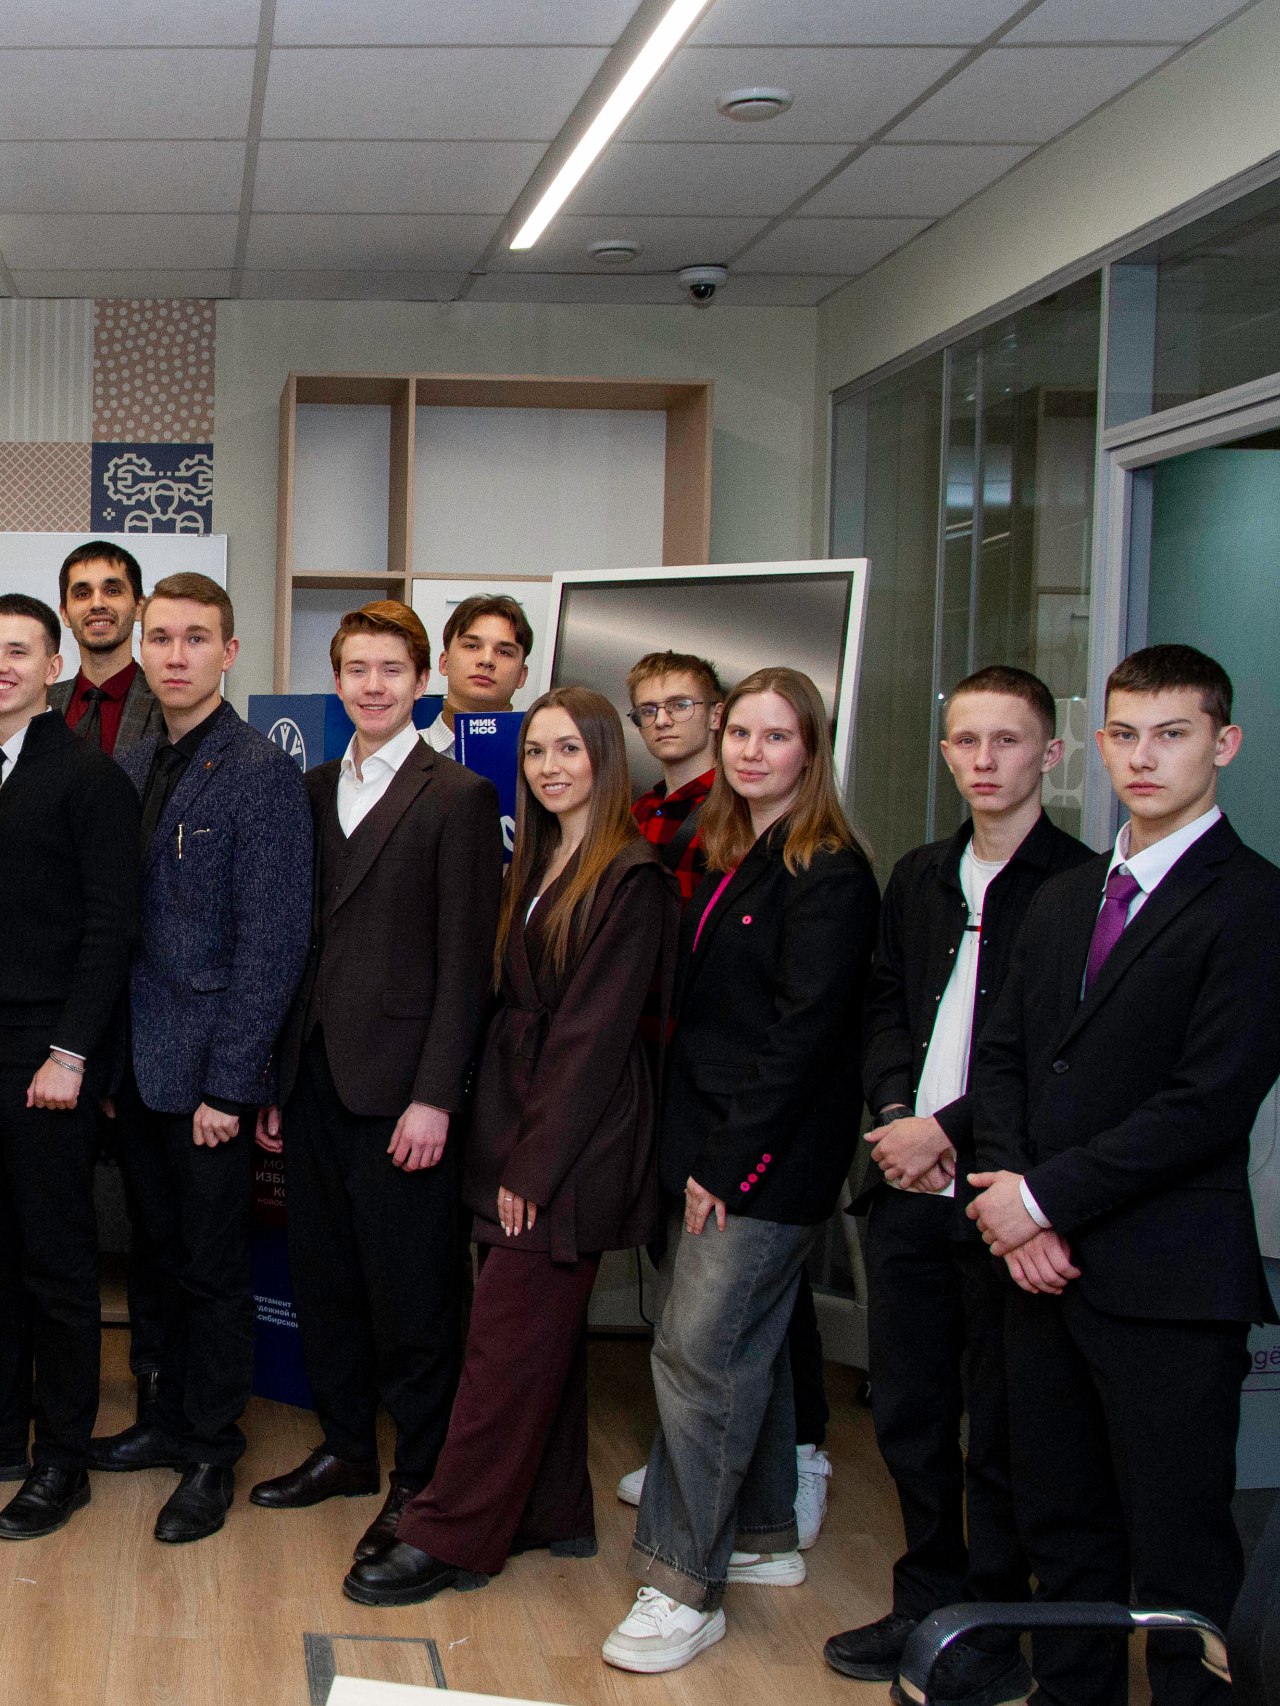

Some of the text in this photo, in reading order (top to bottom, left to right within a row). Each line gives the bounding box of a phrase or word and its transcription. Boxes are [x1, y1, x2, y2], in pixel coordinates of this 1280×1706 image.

[470, 727, 497, 735] НСО
[257, 1304, 290, 1317] дежной
[256, 1314, 299, 1328] сибирско
